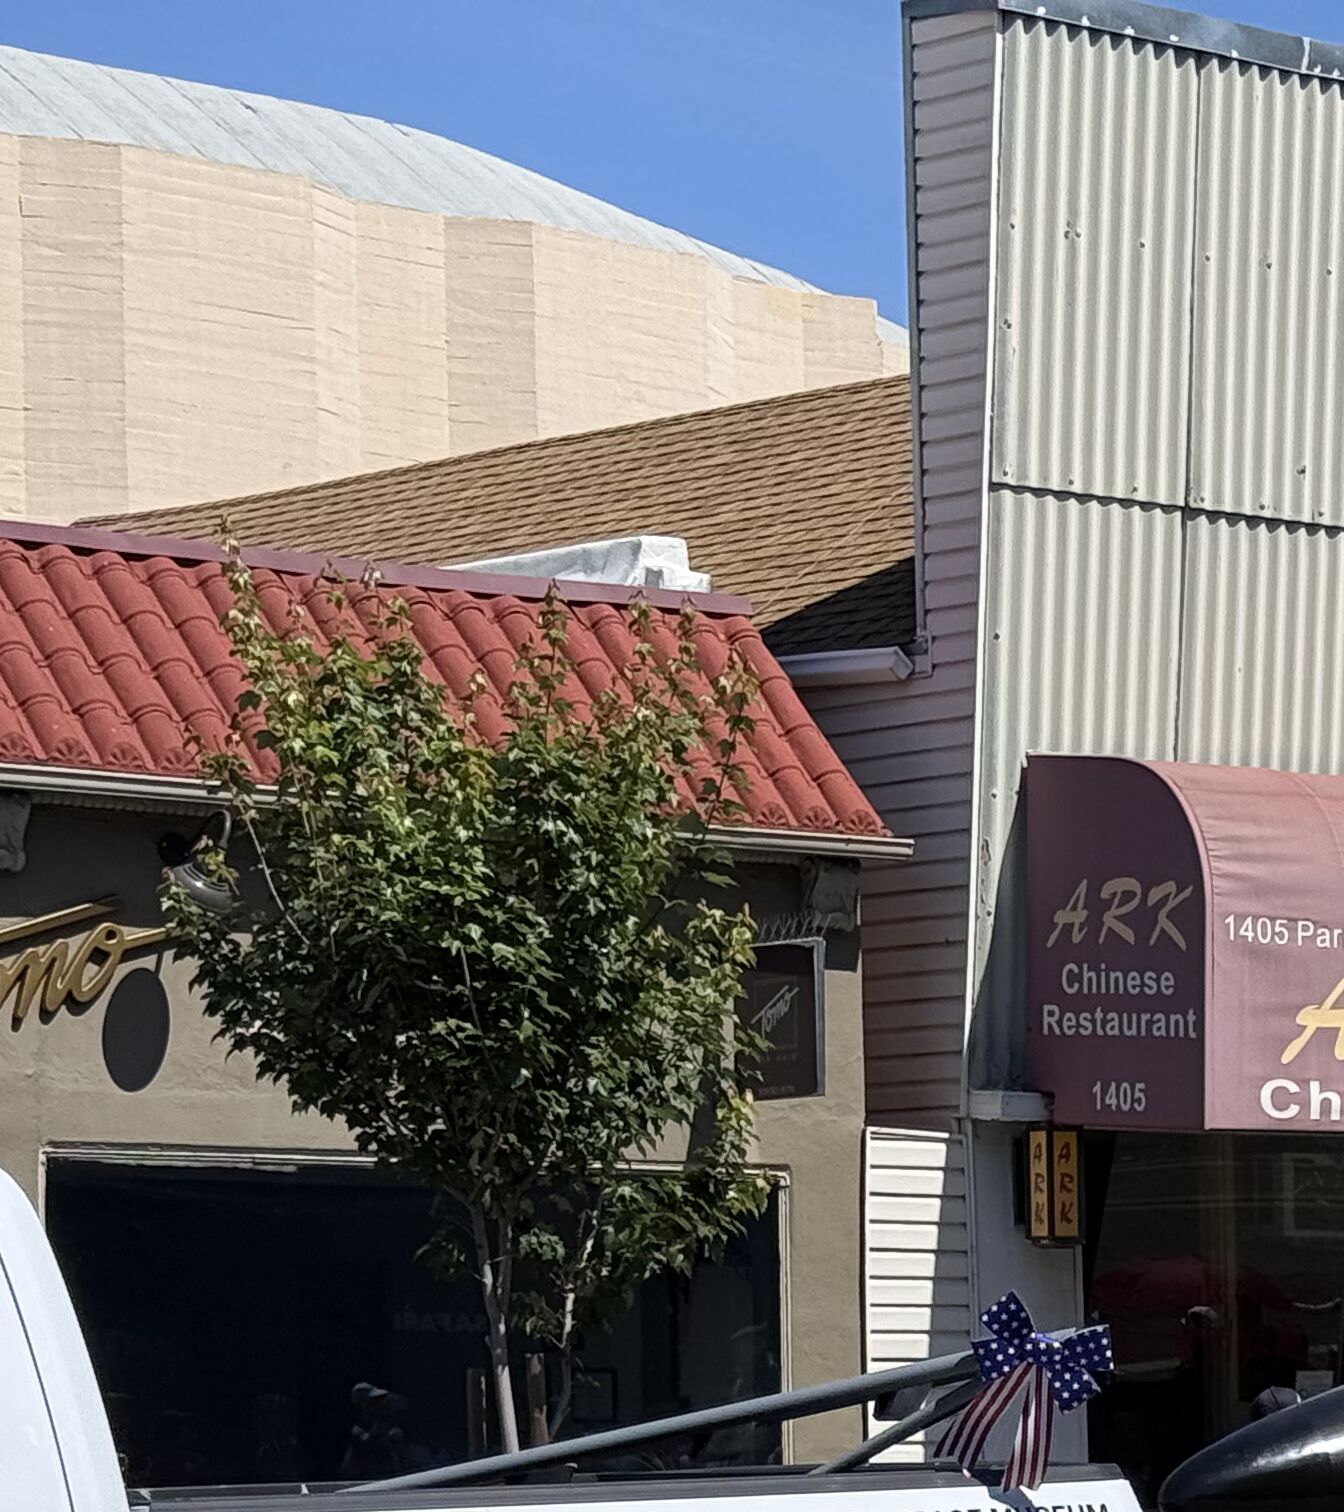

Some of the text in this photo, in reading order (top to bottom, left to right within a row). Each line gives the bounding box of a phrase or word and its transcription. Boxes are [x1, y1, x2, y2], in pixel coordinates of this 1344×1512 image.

[1046, 877, 1194, 952] ARK
[1224, 914, 1289, 945] 1405
[1061, 963, 1176, 996] Chinese
[1043, 1004, 1197, 1039] Restaurant
[1092, 1081, 1146, 1112] 1405
[1057, 1142, 1074, 1225] ARK
